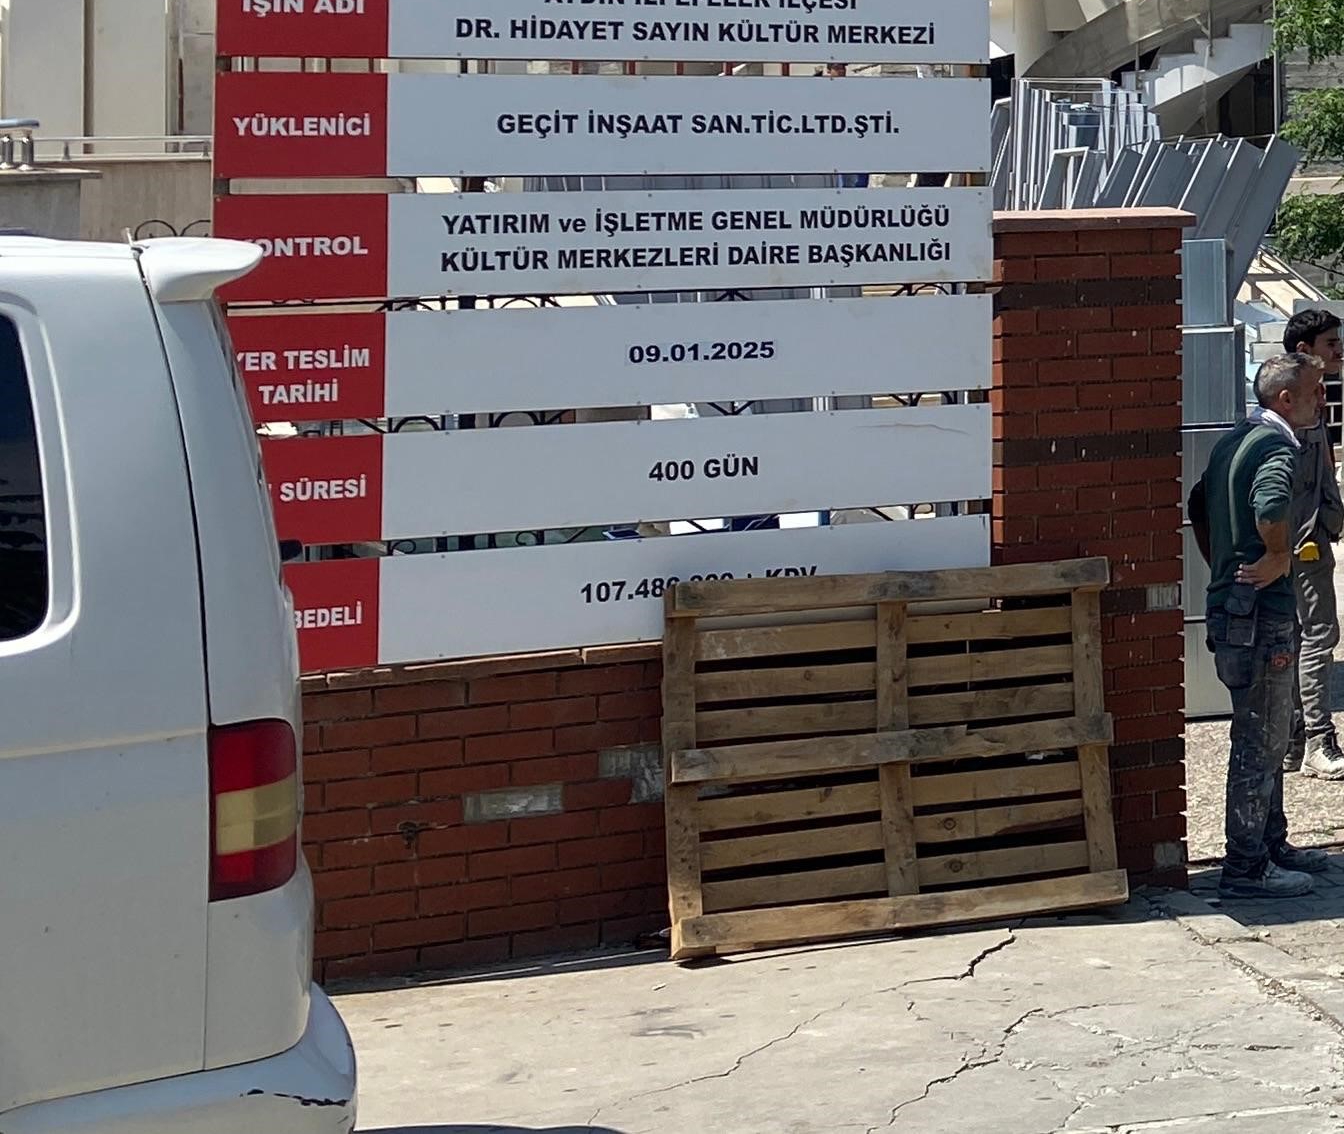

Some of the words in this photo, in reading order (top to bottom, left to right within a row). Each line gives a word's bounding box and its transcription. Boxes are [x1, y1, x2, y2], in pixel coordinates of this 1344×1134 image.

[456, 18, 500, 39] DR.
[510, 14, 625, 40] HİDAYET
[632, 21, 709, 42] SAYIN
[718, 19, 820, 43] KÜLTÜR
[827, 22, 935, 45] MERKEZİ
[232, 112, 370, 136] YÜKLENİCİ
[497, 109, 579, 139] GEÇİT
[588, 109, 683, 139] İNŞAAT
[691, 110, 899, 139] SAN.TİC.LTD.ŞTİ.
[441, 213, 550, 235] YATIRIM
[558, 218, 587, 233] ve
[595, 208, 703, 238] İŞLETME
[711, 210, 792, 231] GENEL
[800, 204, 949, 229] MÜDÜRLÜĞÜ
[252, 236, 369, 257] ONTROL
[441, 246, 549, 272] KÜLTÜR
[557, 241, 719, 269] MERKEZLERİ
[728, 240, 800, 266] DAİRE
[808, 237, 950, 268] BAŞKANLIĞI
[284, 344, 370, 370] TESLİM
[629, 341, 775, 364] 09.01.2025
[258, 378, 338, 405] TARİHİ
[648, 460, 695, 482] 400
[703, 453, 758, 479] GÜN
[279, 473, 366, 502] SÜRESİ
